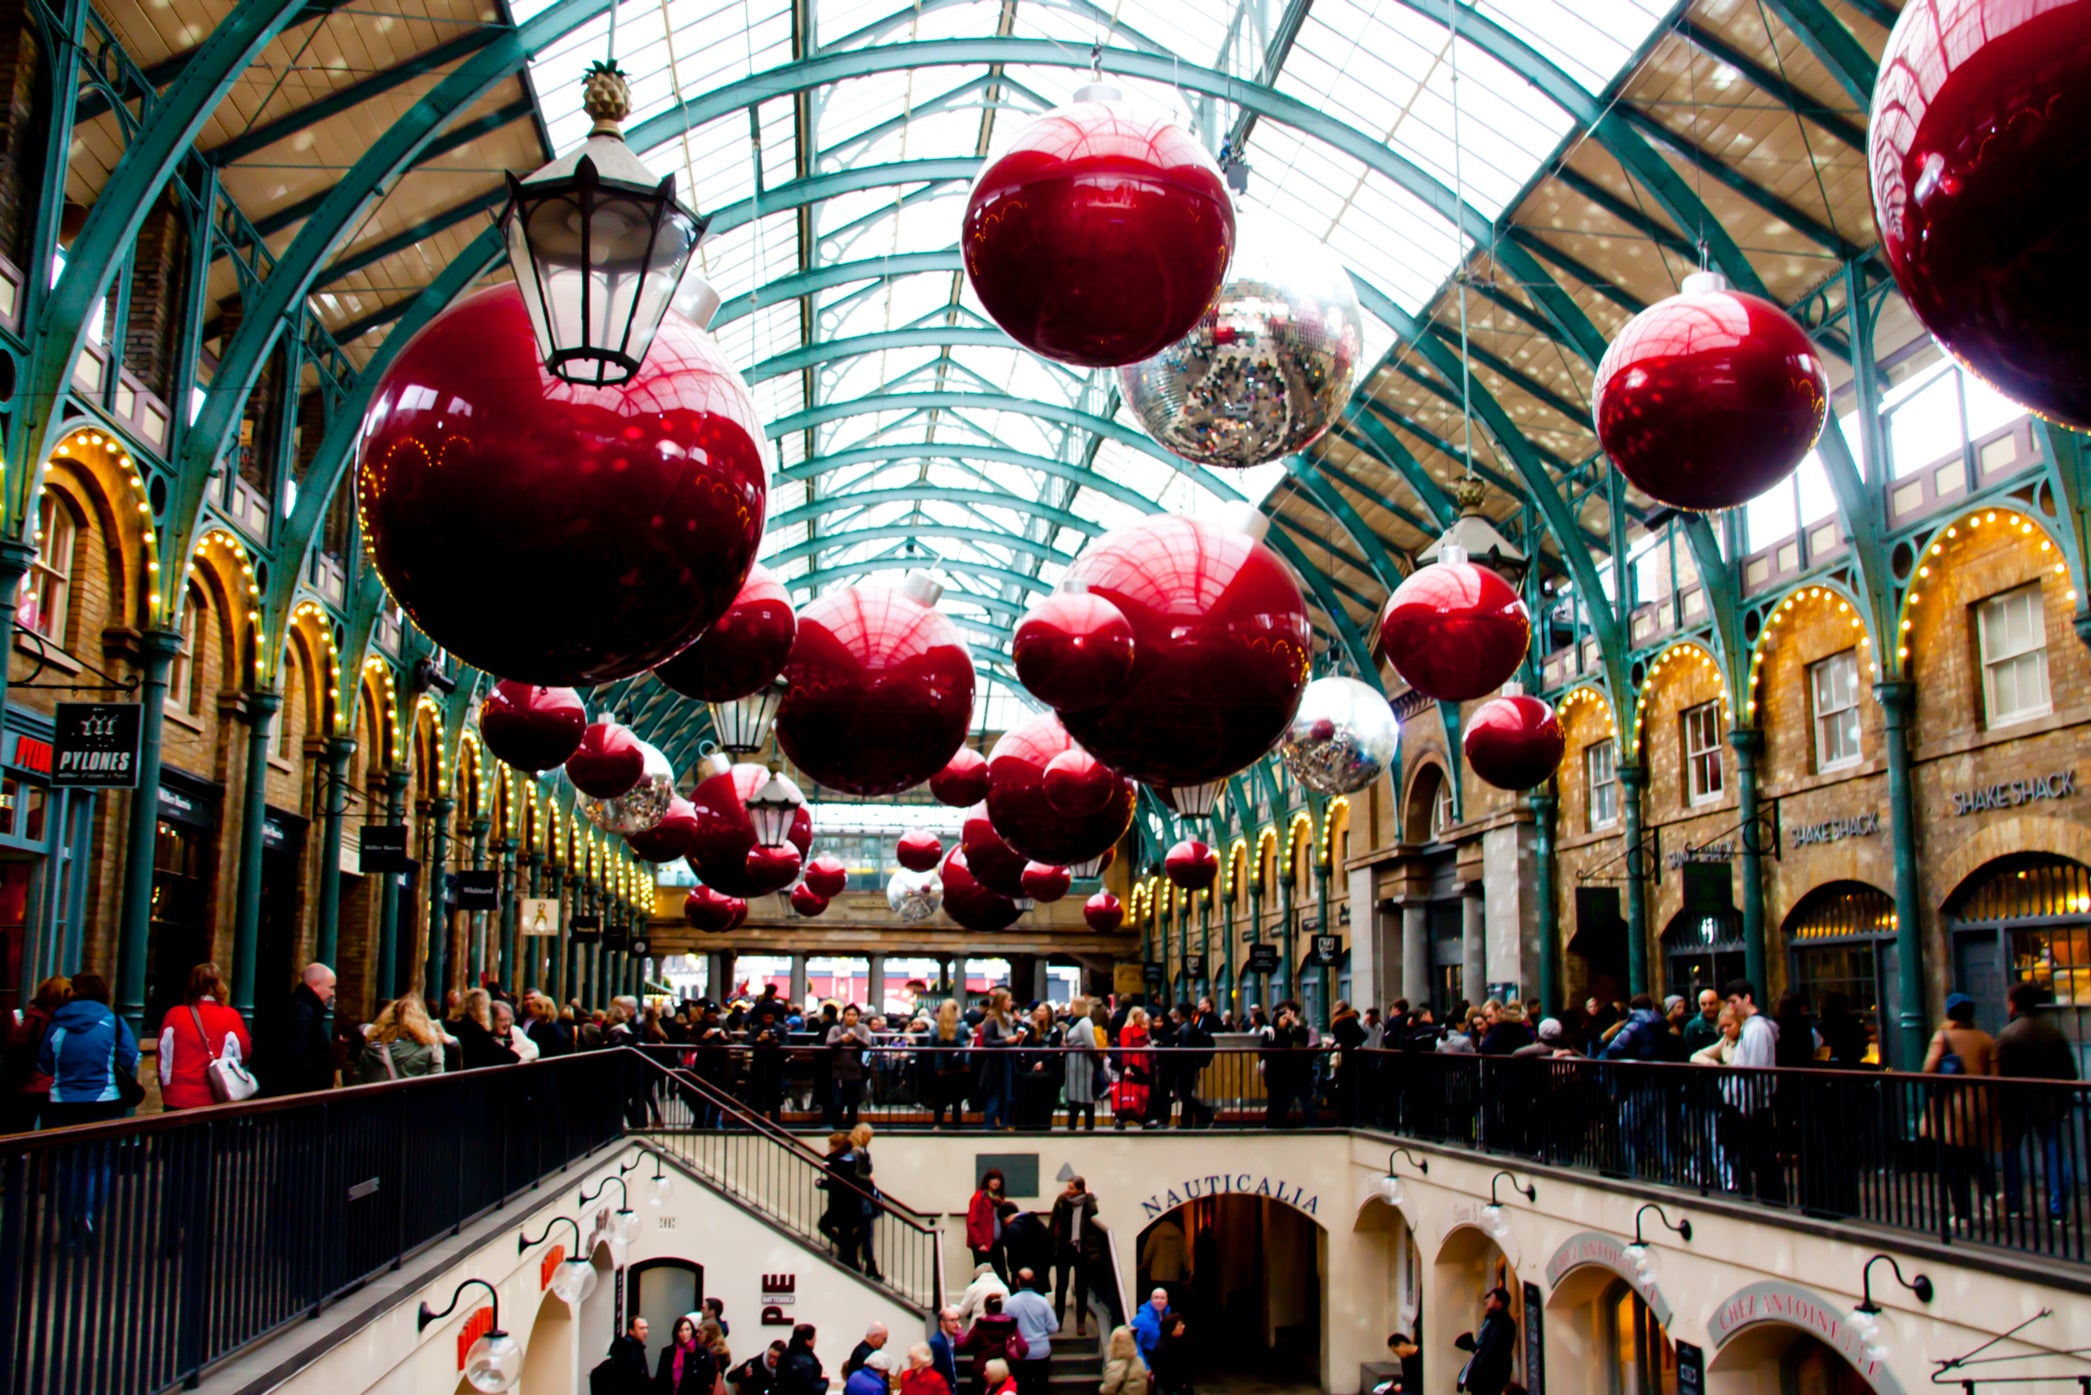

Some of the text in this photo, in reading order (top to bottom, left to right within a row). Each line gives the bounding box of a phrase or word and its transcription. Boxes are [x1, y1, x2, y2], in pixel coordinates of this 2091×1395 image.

[59, 751, 131, 771] PYLONES
[1952, 770, 2077, 816] SHAKE SHACK
[1790, 811, 1880, 849] SHAKE SHACK
[1141, 1174, 1319, 1220] NAUTICALIA
[1718, 1295, 1756, 1331] CHEZ
